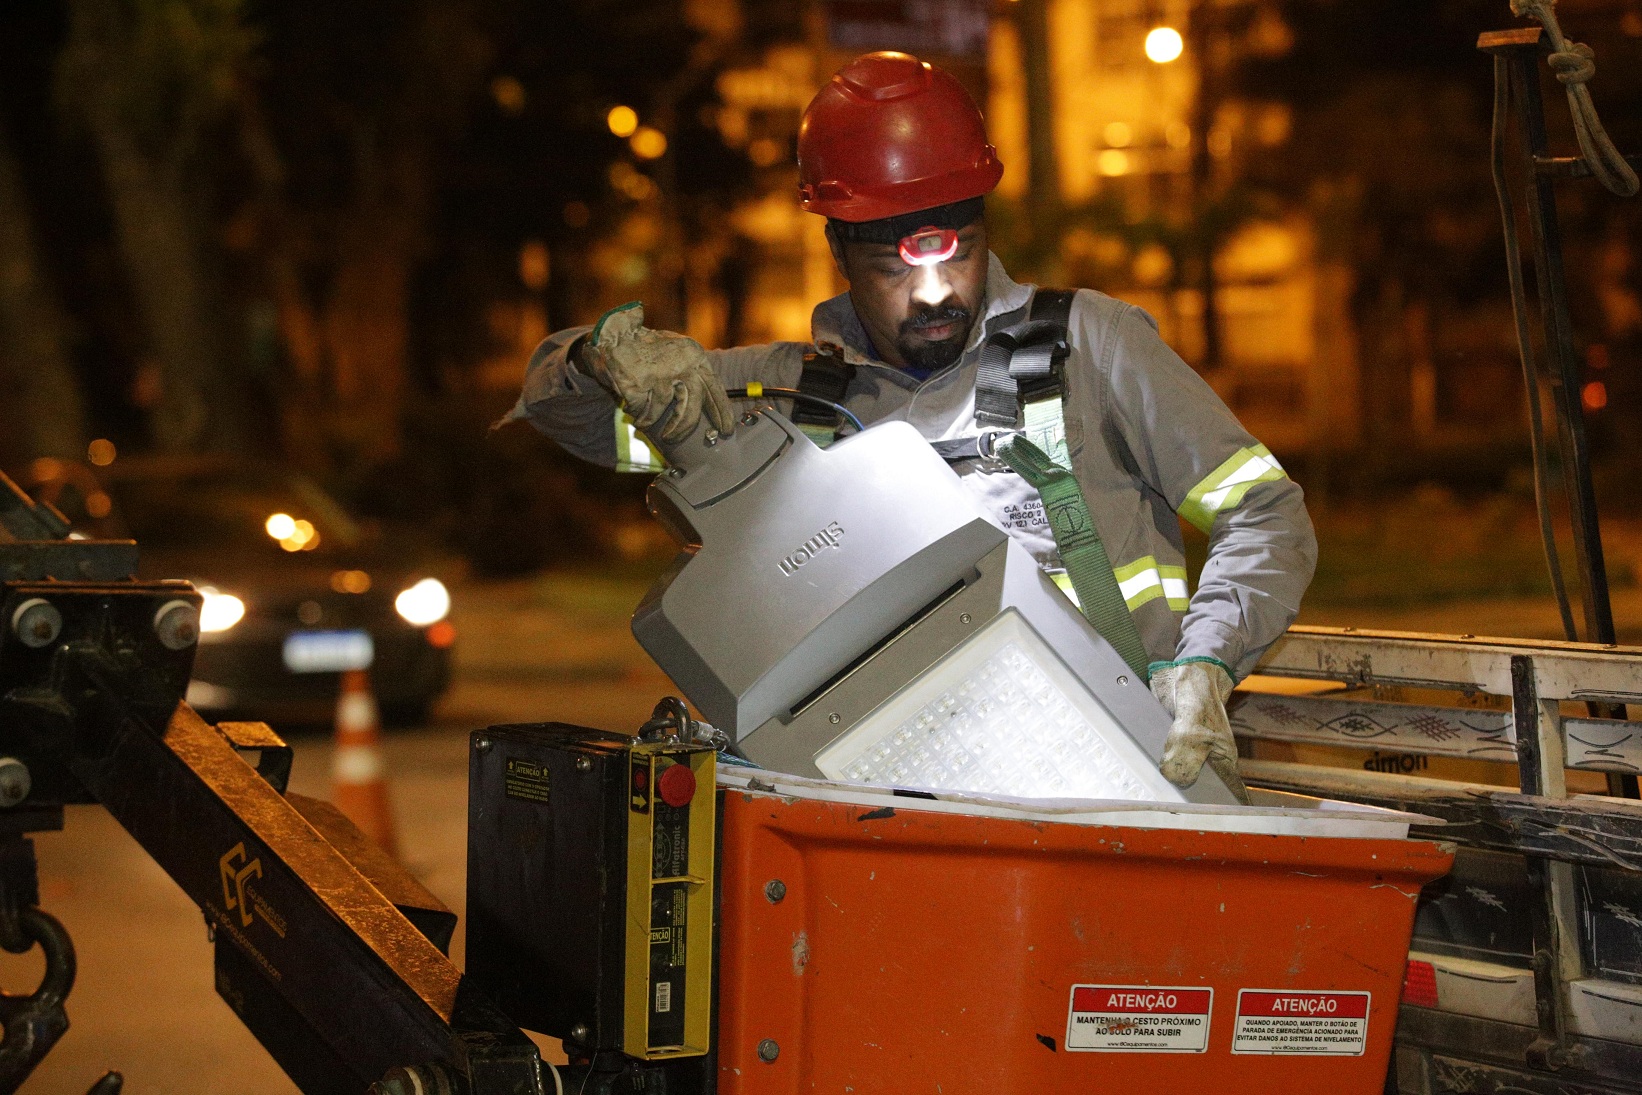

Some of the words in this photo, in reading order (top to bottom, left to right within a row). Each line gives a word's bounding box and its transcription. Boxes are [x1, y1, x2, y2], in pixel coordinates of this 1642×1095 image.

[1010, 511, 1033, 520] RISCO
[777, 521, 844, 577] simon
[1363, 751, 1428, 773] simon
[672, 825, 681, 876] Alfatronic
[650, 930, 669, 941] TENÇÃO
[1107, 992, 1177, 1010] ATENÇÃO
[1272, 996, 1337, 1015] ATENÇÃO
[1076, 1016, 1122, 1024] MANTENHA
[1132, 1017, 1159, 1026] CESTO
[1161, 1016, 1201, 1026] PRÓXIMO
[1133, 1028, 1155, 1036] PARA
[1276, 1027, 1313, 1035] EMERGÊNCIA
